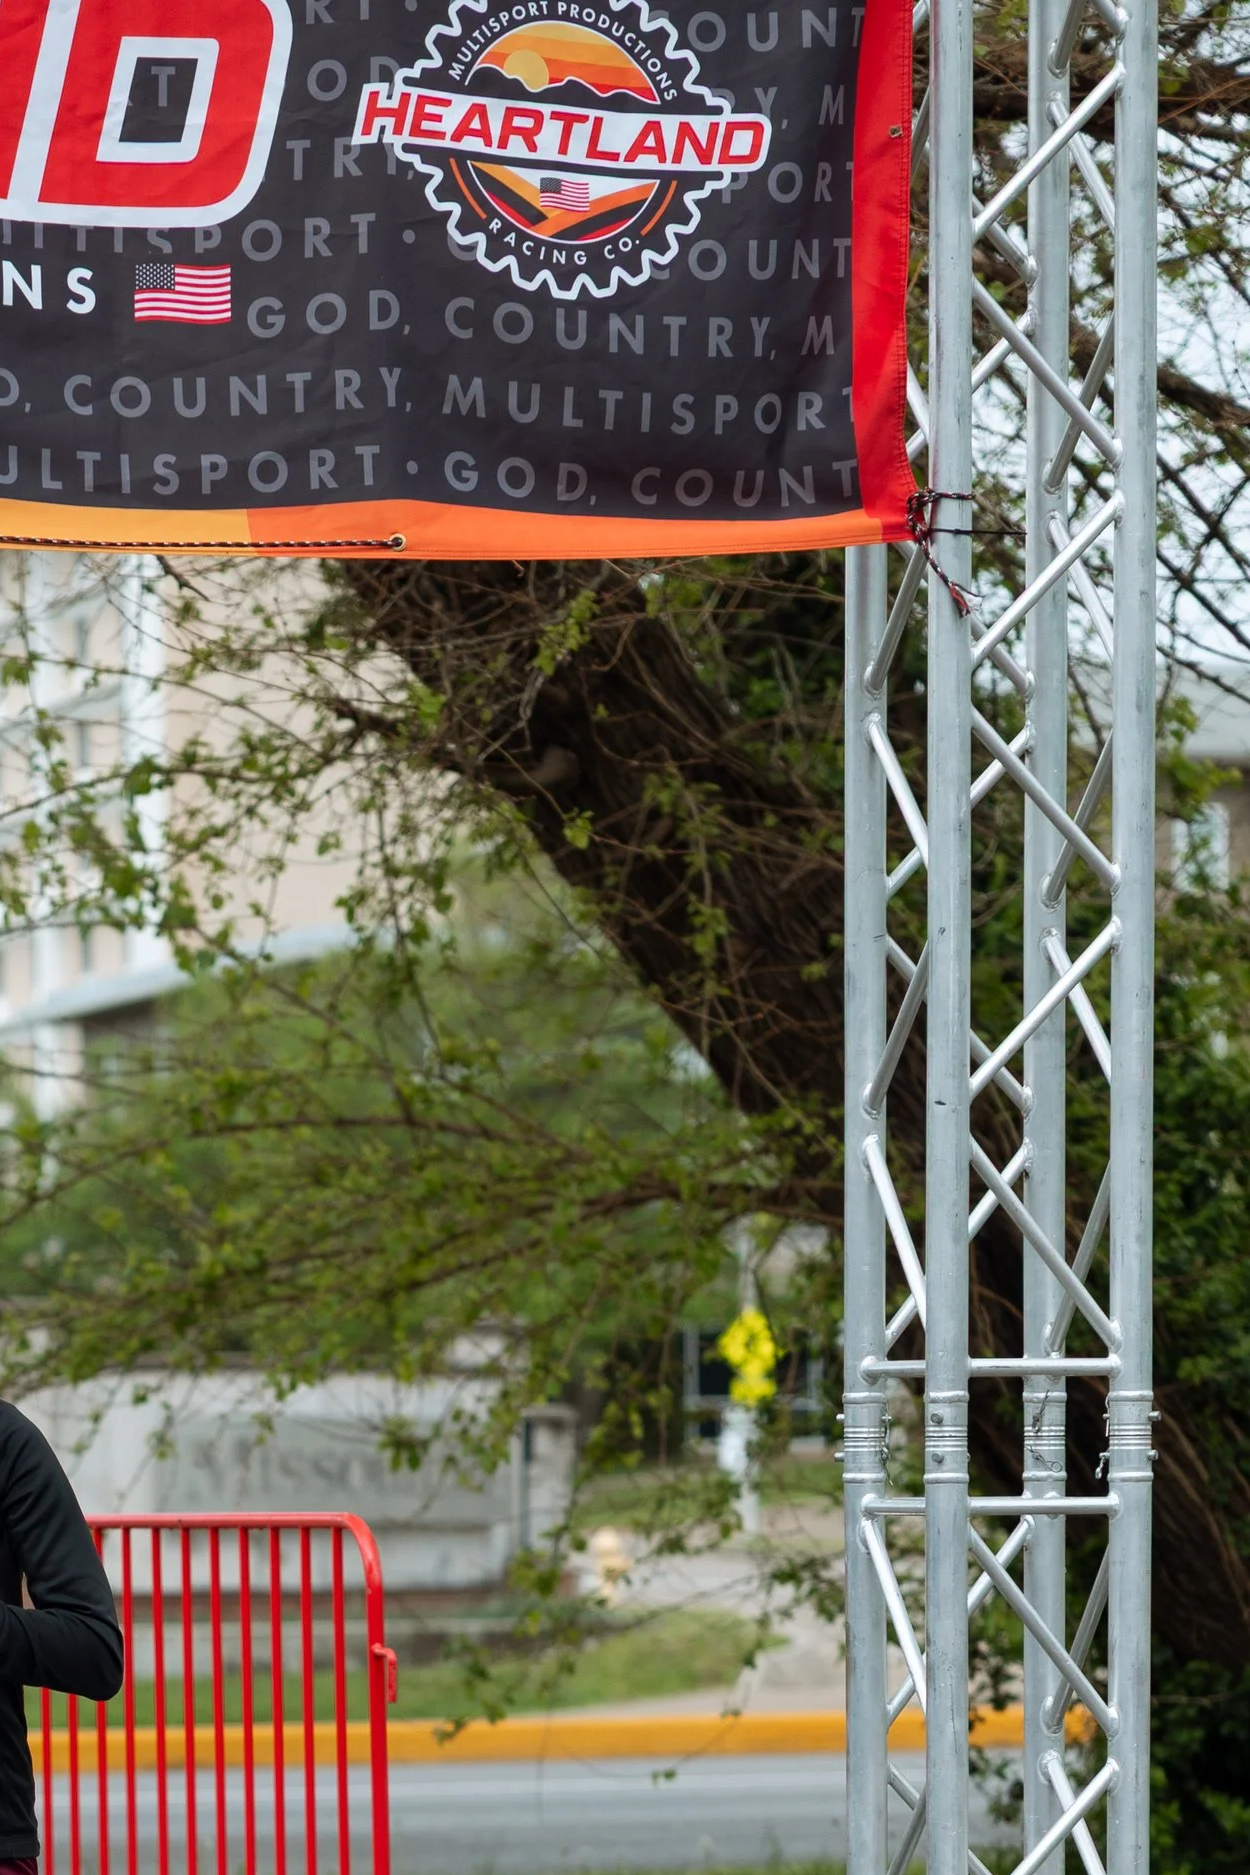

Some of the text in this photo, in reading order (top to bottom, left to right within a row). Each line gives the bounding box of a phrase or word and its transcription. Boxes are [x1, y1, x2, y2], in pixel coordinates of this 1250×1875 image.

[448, 1, 677, 100] MULTISPORT PRODUCTIONS
[361, 90, 764, 166] HEARTLAND
[488, 217, 587, 266] RACING
[603, 237, 641, 260] CO.
[247, 289, 411, 339] GOD,
[444, 296, 776, 360] COUNTRY,
[64, 366, 412, 419] COUNTRY,
[444, 452, 597, 506] GOD,
